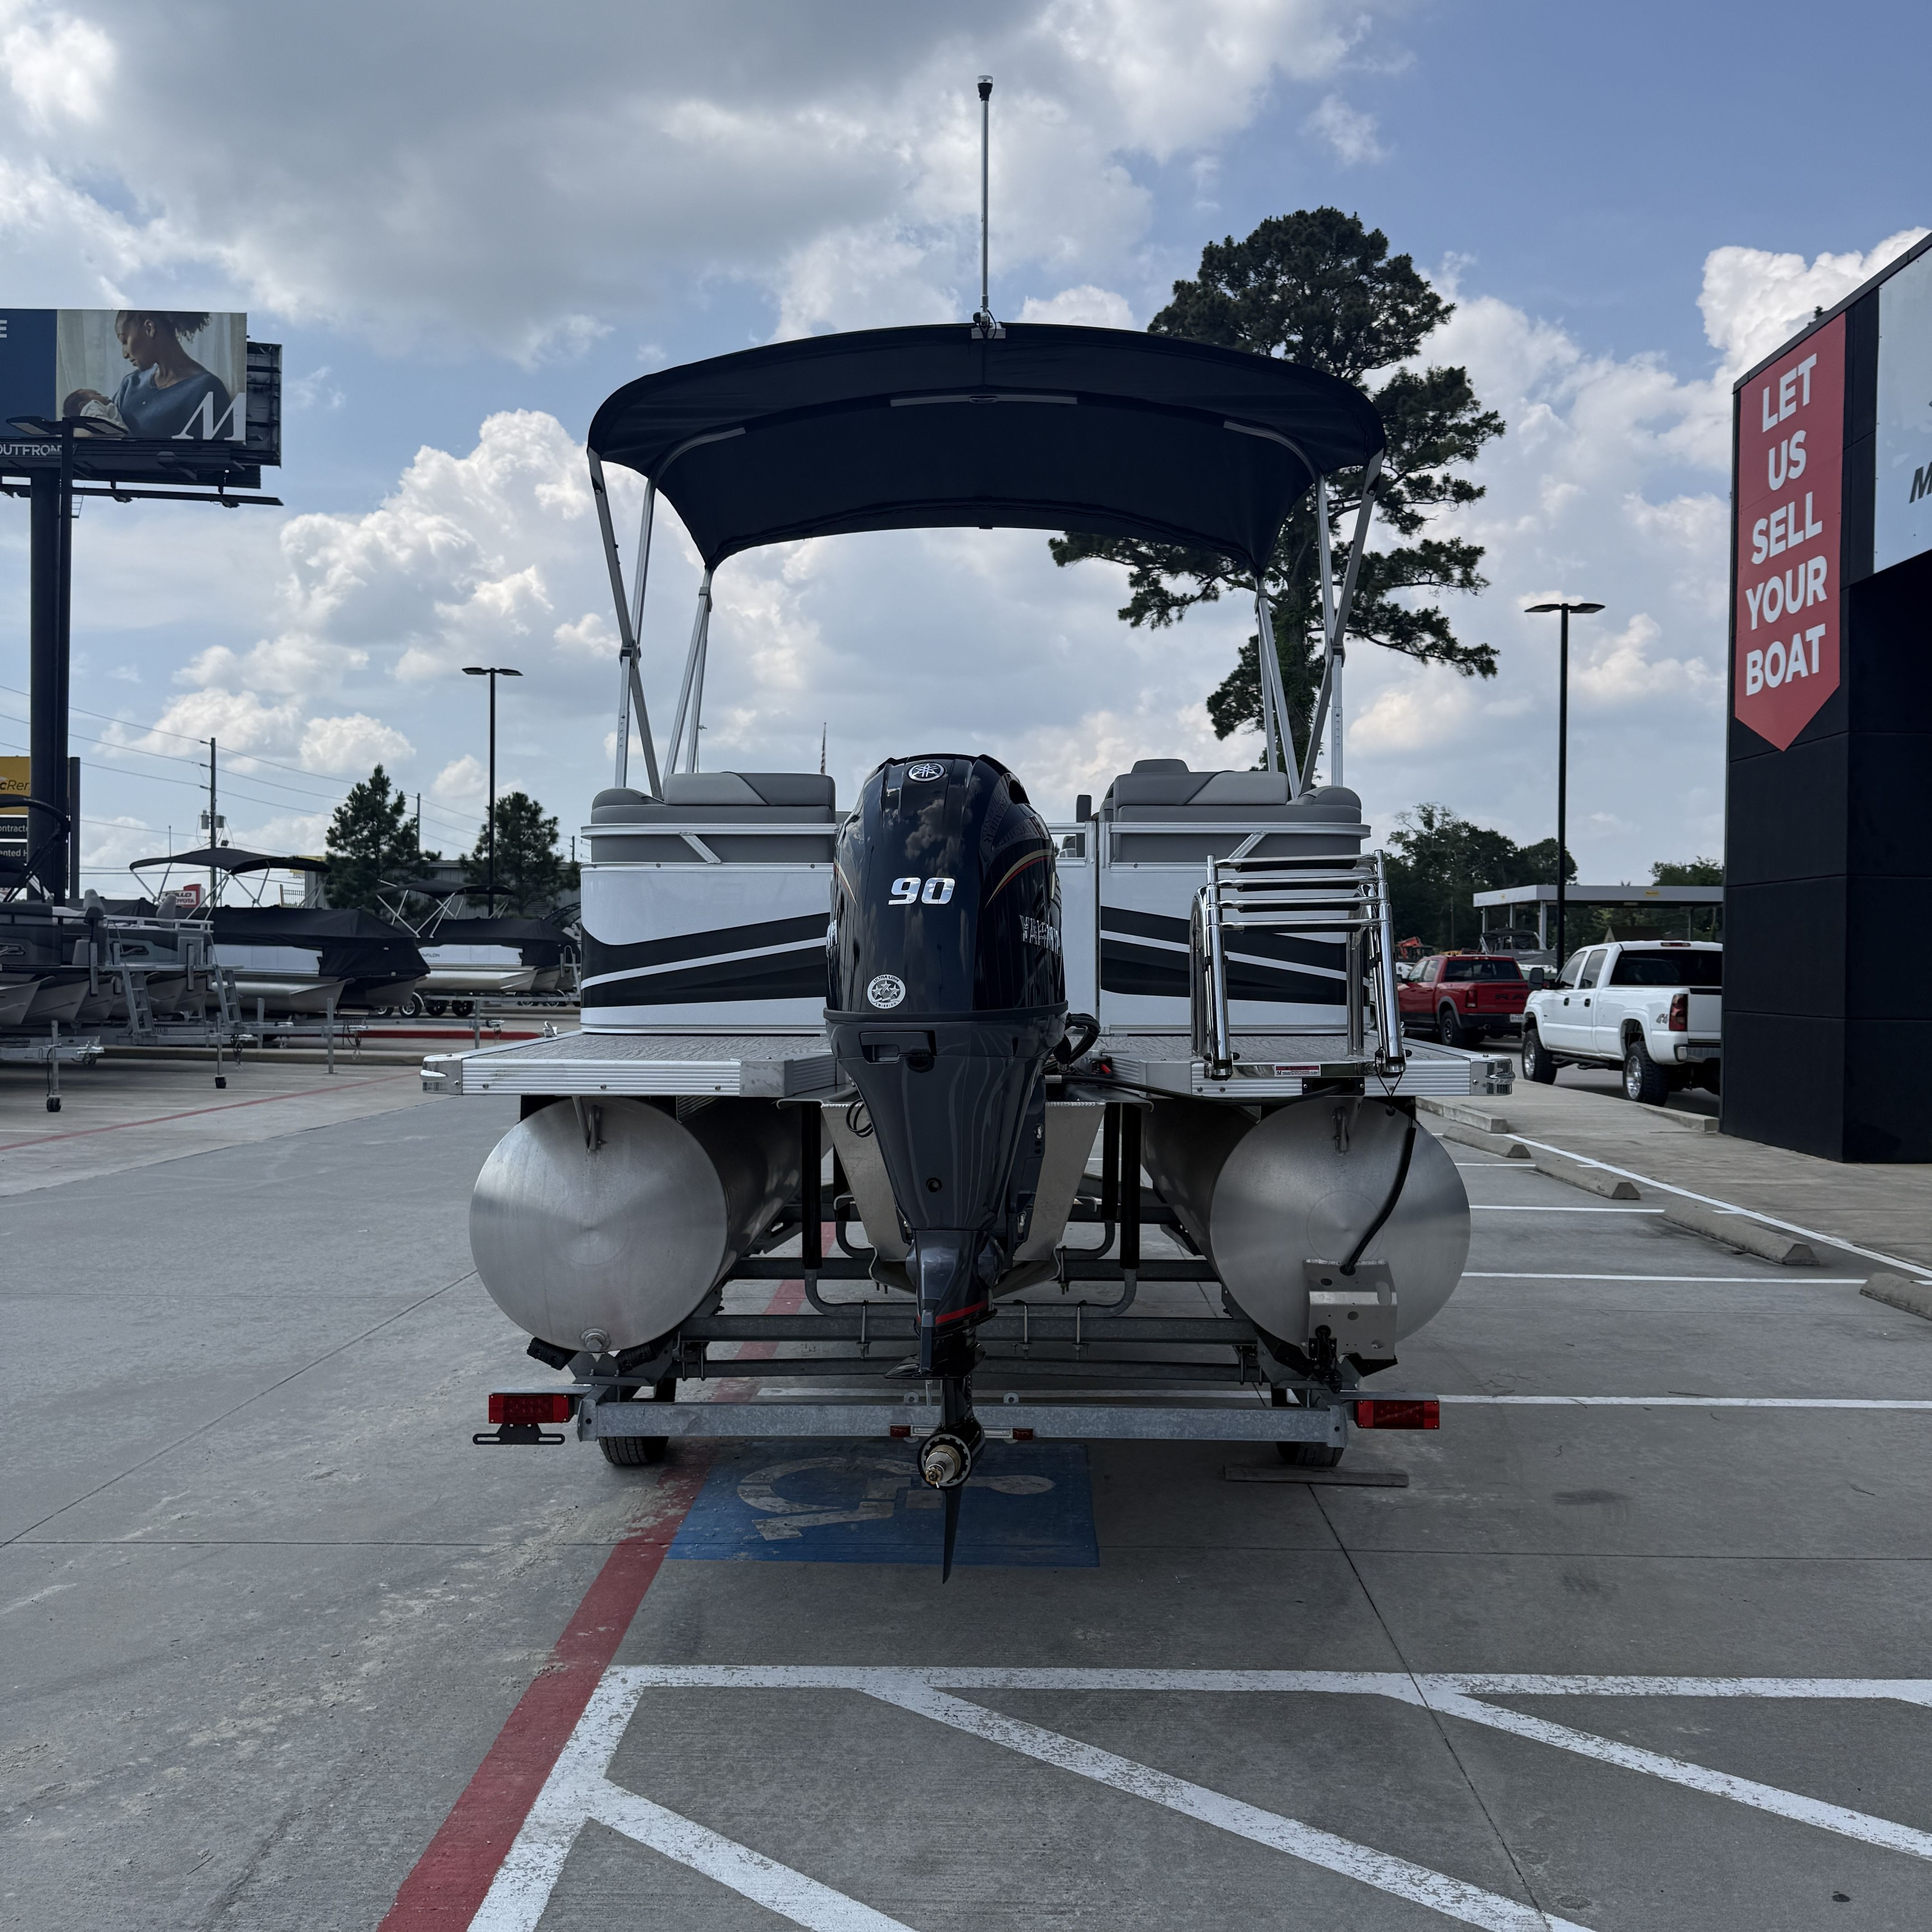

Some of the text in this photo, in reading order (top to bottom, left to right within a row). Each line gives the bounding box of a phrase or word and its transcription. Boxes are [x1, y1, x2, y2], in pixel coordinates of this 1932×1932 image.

[1762, 354, 1817, 432] LET
[1768, 430, 1807, 491] US
[1751, 492, 1822, 565] SELL
[1745, 556, 1827, 630] YOUR
[1746, 624, 1826, 696] BOAT
[888, 877, 955, 906] 90
